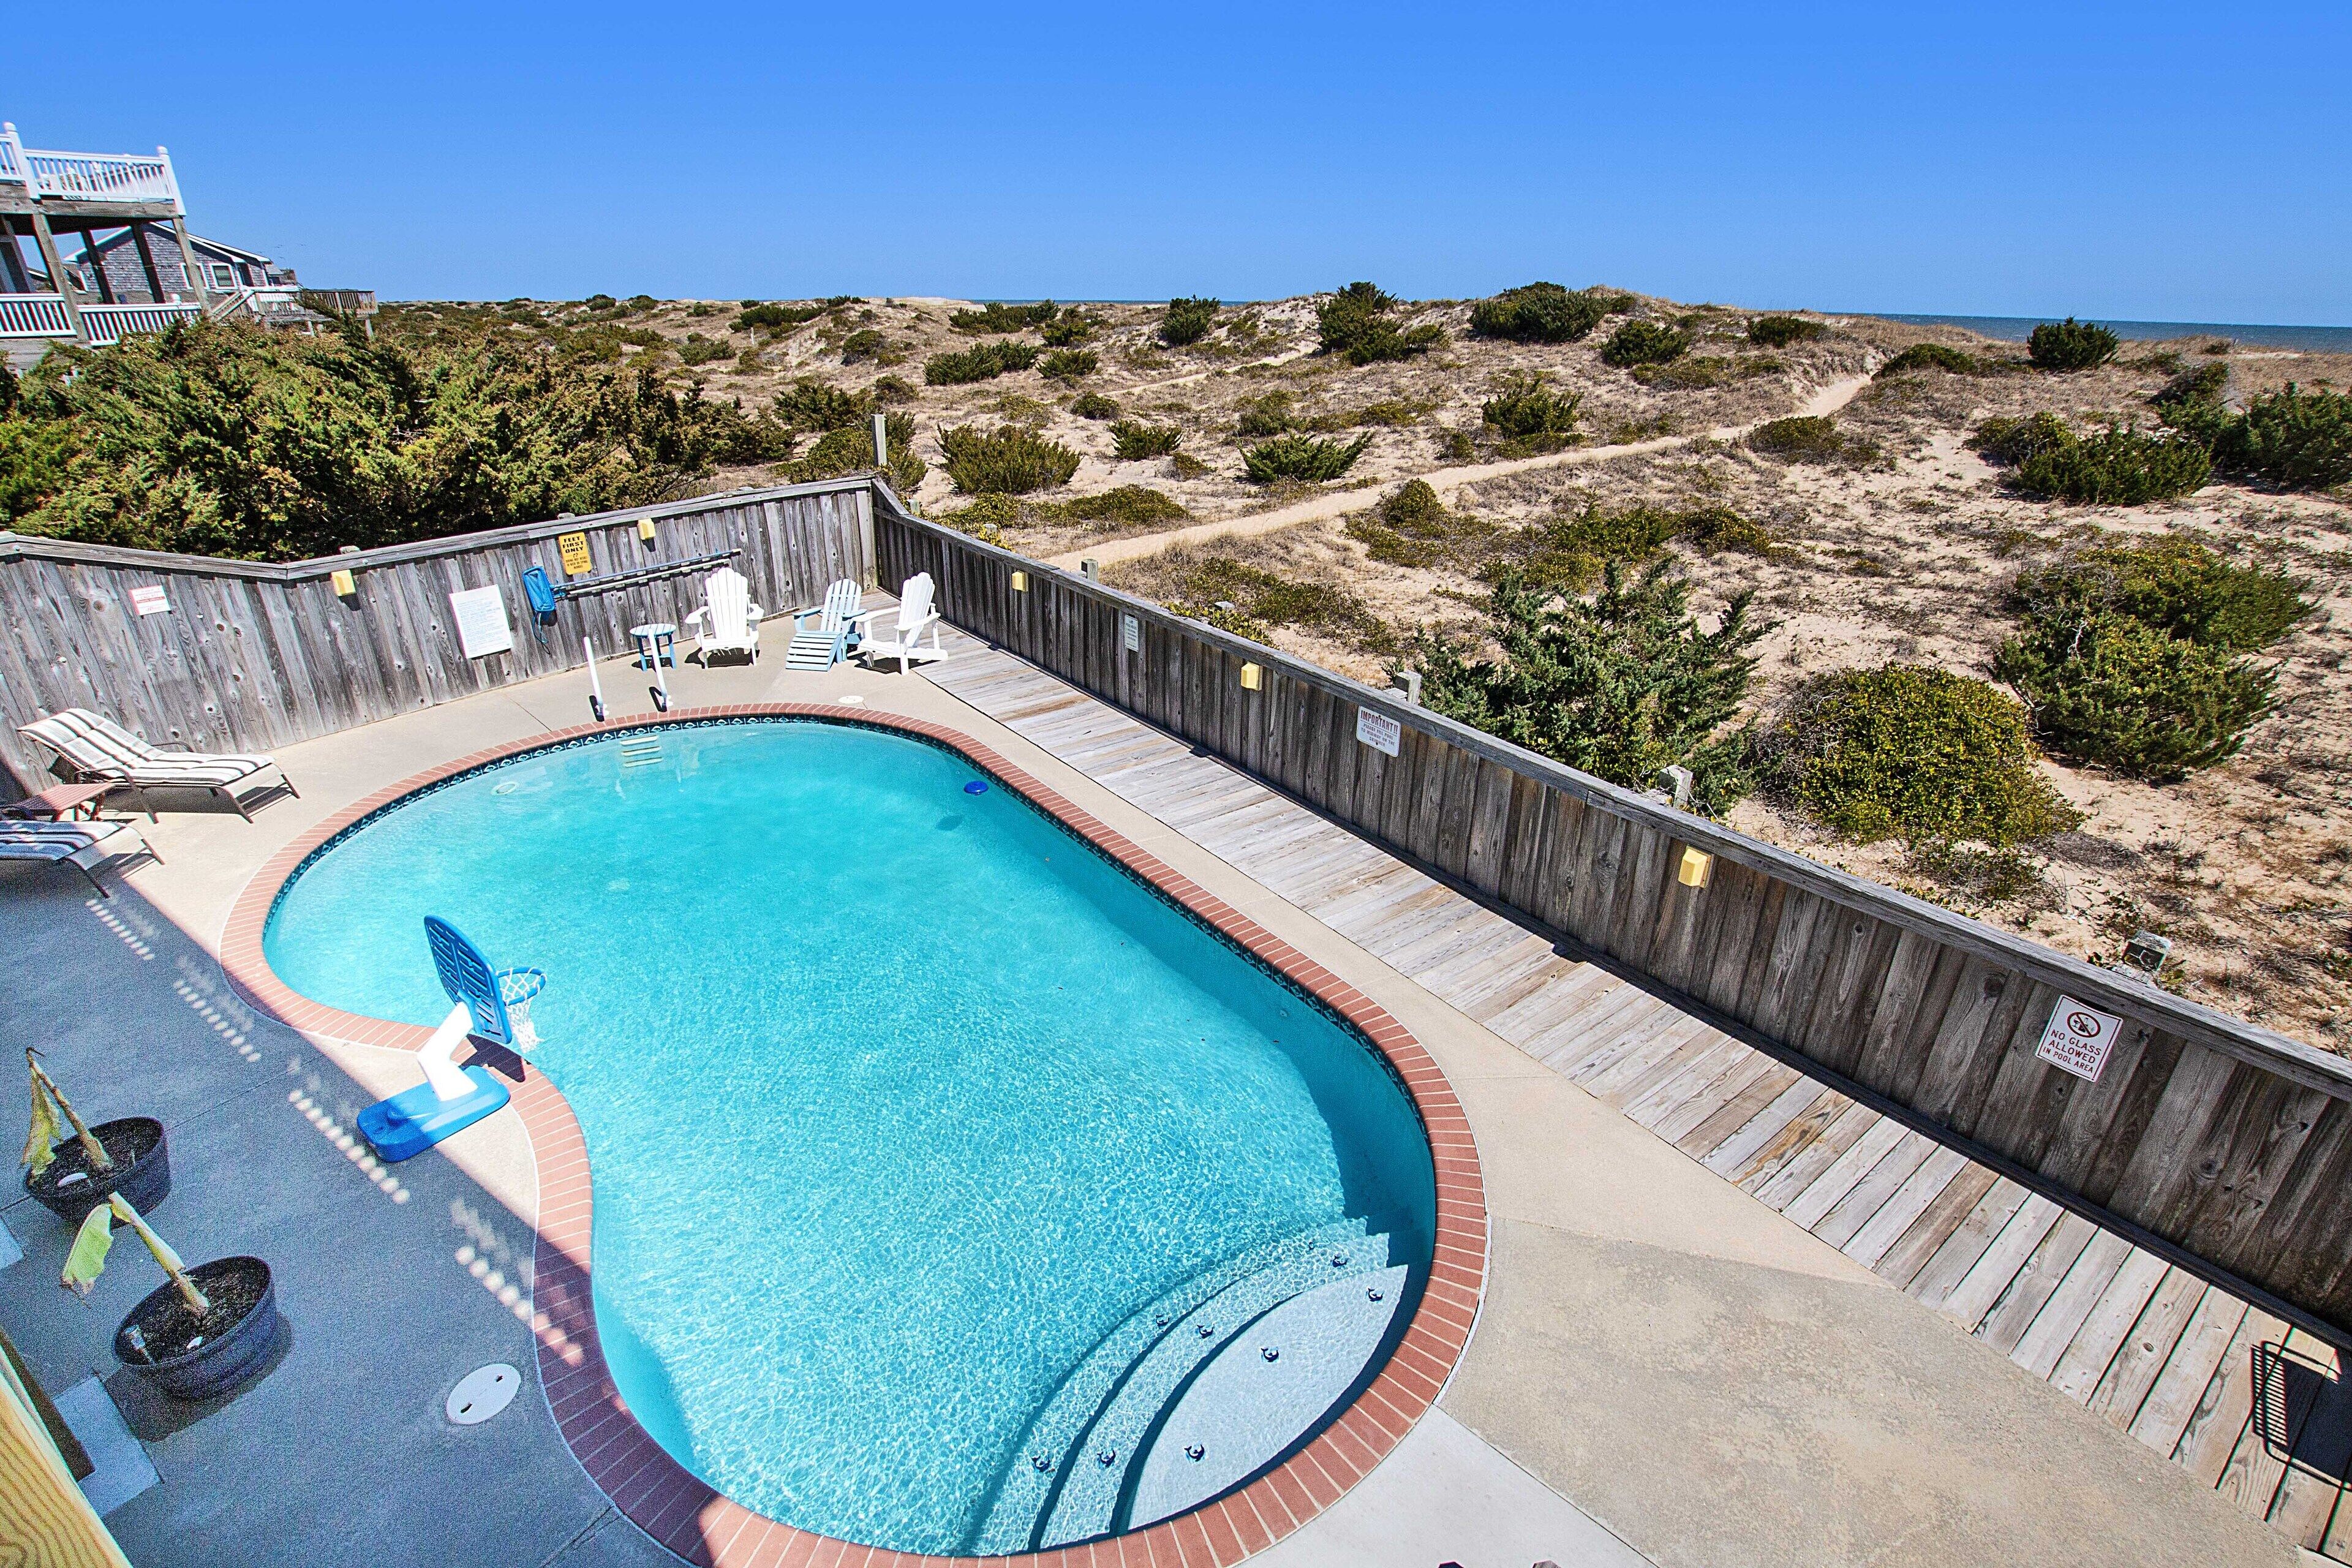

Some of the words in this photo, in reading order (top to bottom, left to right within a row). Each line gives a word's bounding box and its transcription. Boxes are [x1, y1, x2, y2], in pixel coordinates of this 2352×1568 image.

[2048, 1040, 2095, 1063] ALLOWED
[2051, 1029, 2066, 1041] NO
[2069, 1038, 2101, 1055] GLASS
[2053, 1052, 2071, 1064] POOL
[2074, 1061, 2094, 1073] AREA
